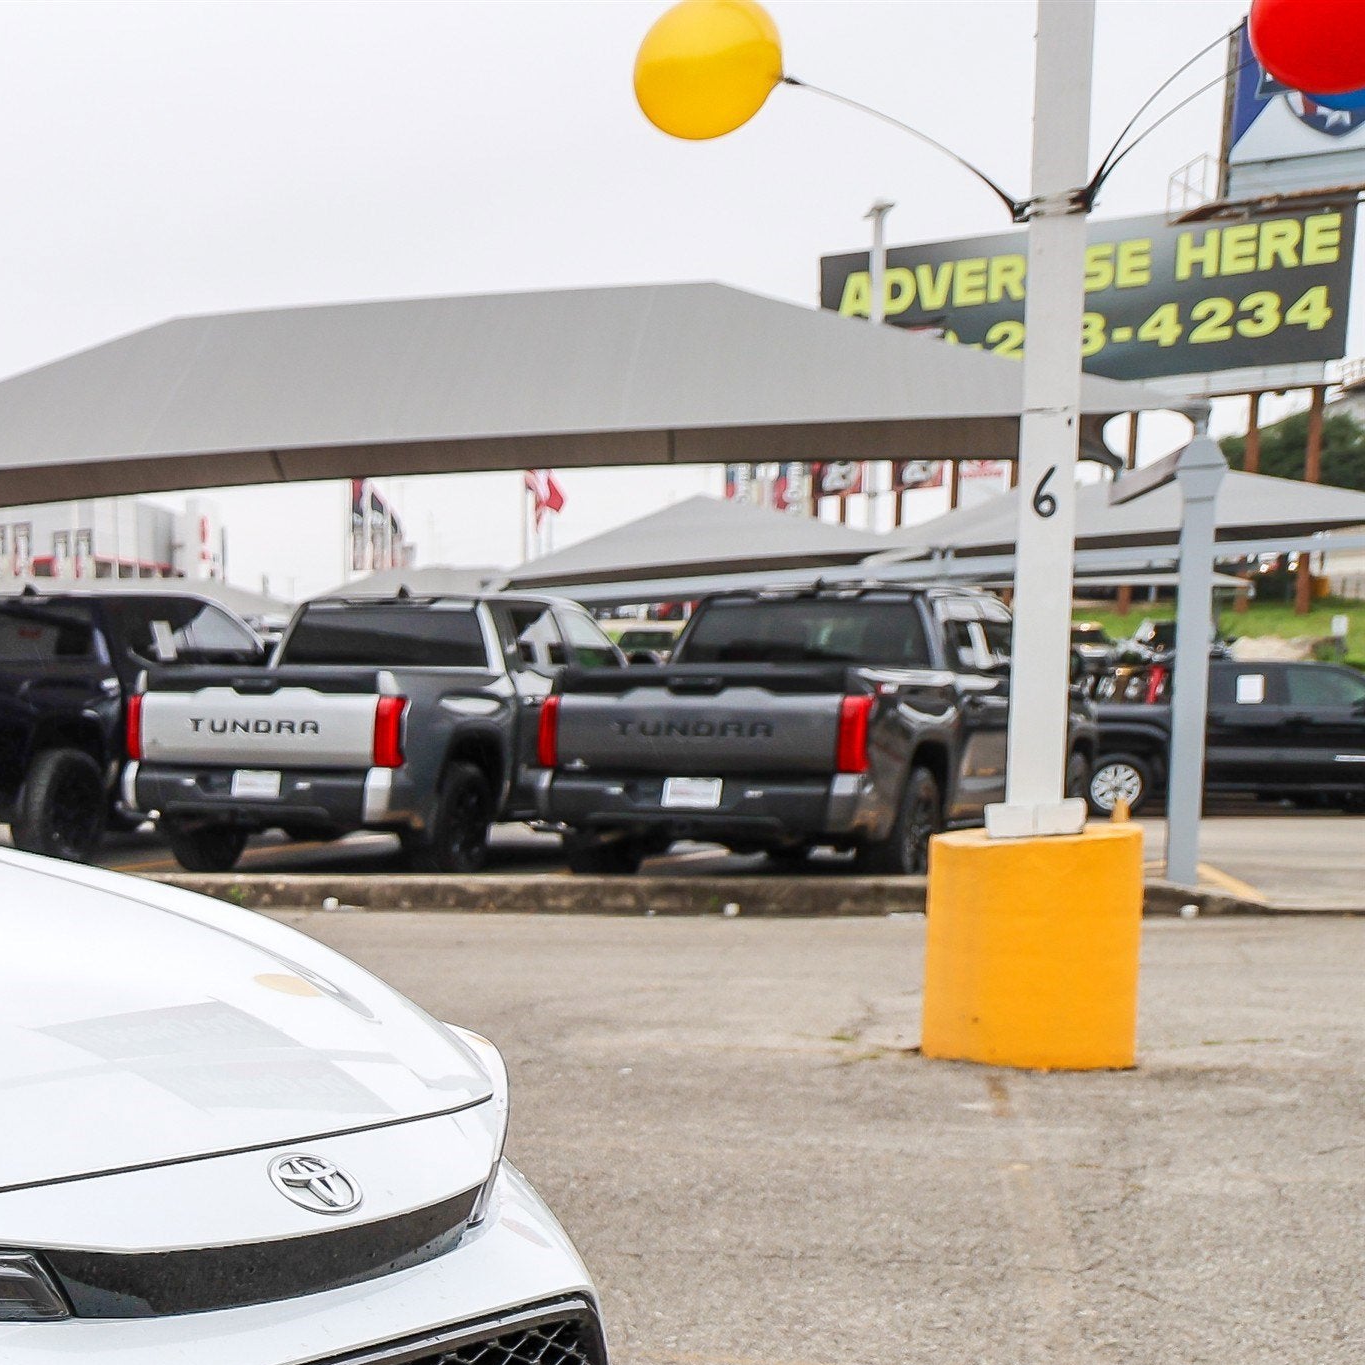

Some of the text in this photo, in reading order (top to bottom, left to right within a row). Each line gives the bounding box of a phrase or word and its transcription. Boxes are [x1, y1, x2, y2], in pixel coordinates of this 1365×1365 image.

[839, 212, 1342, 318] ADVERSE HERE
[1033, 465, 1056, 518] 6
[189, 717, 320, 735] TUNDRA
[616, 719, 773, 738] TUNDRA
